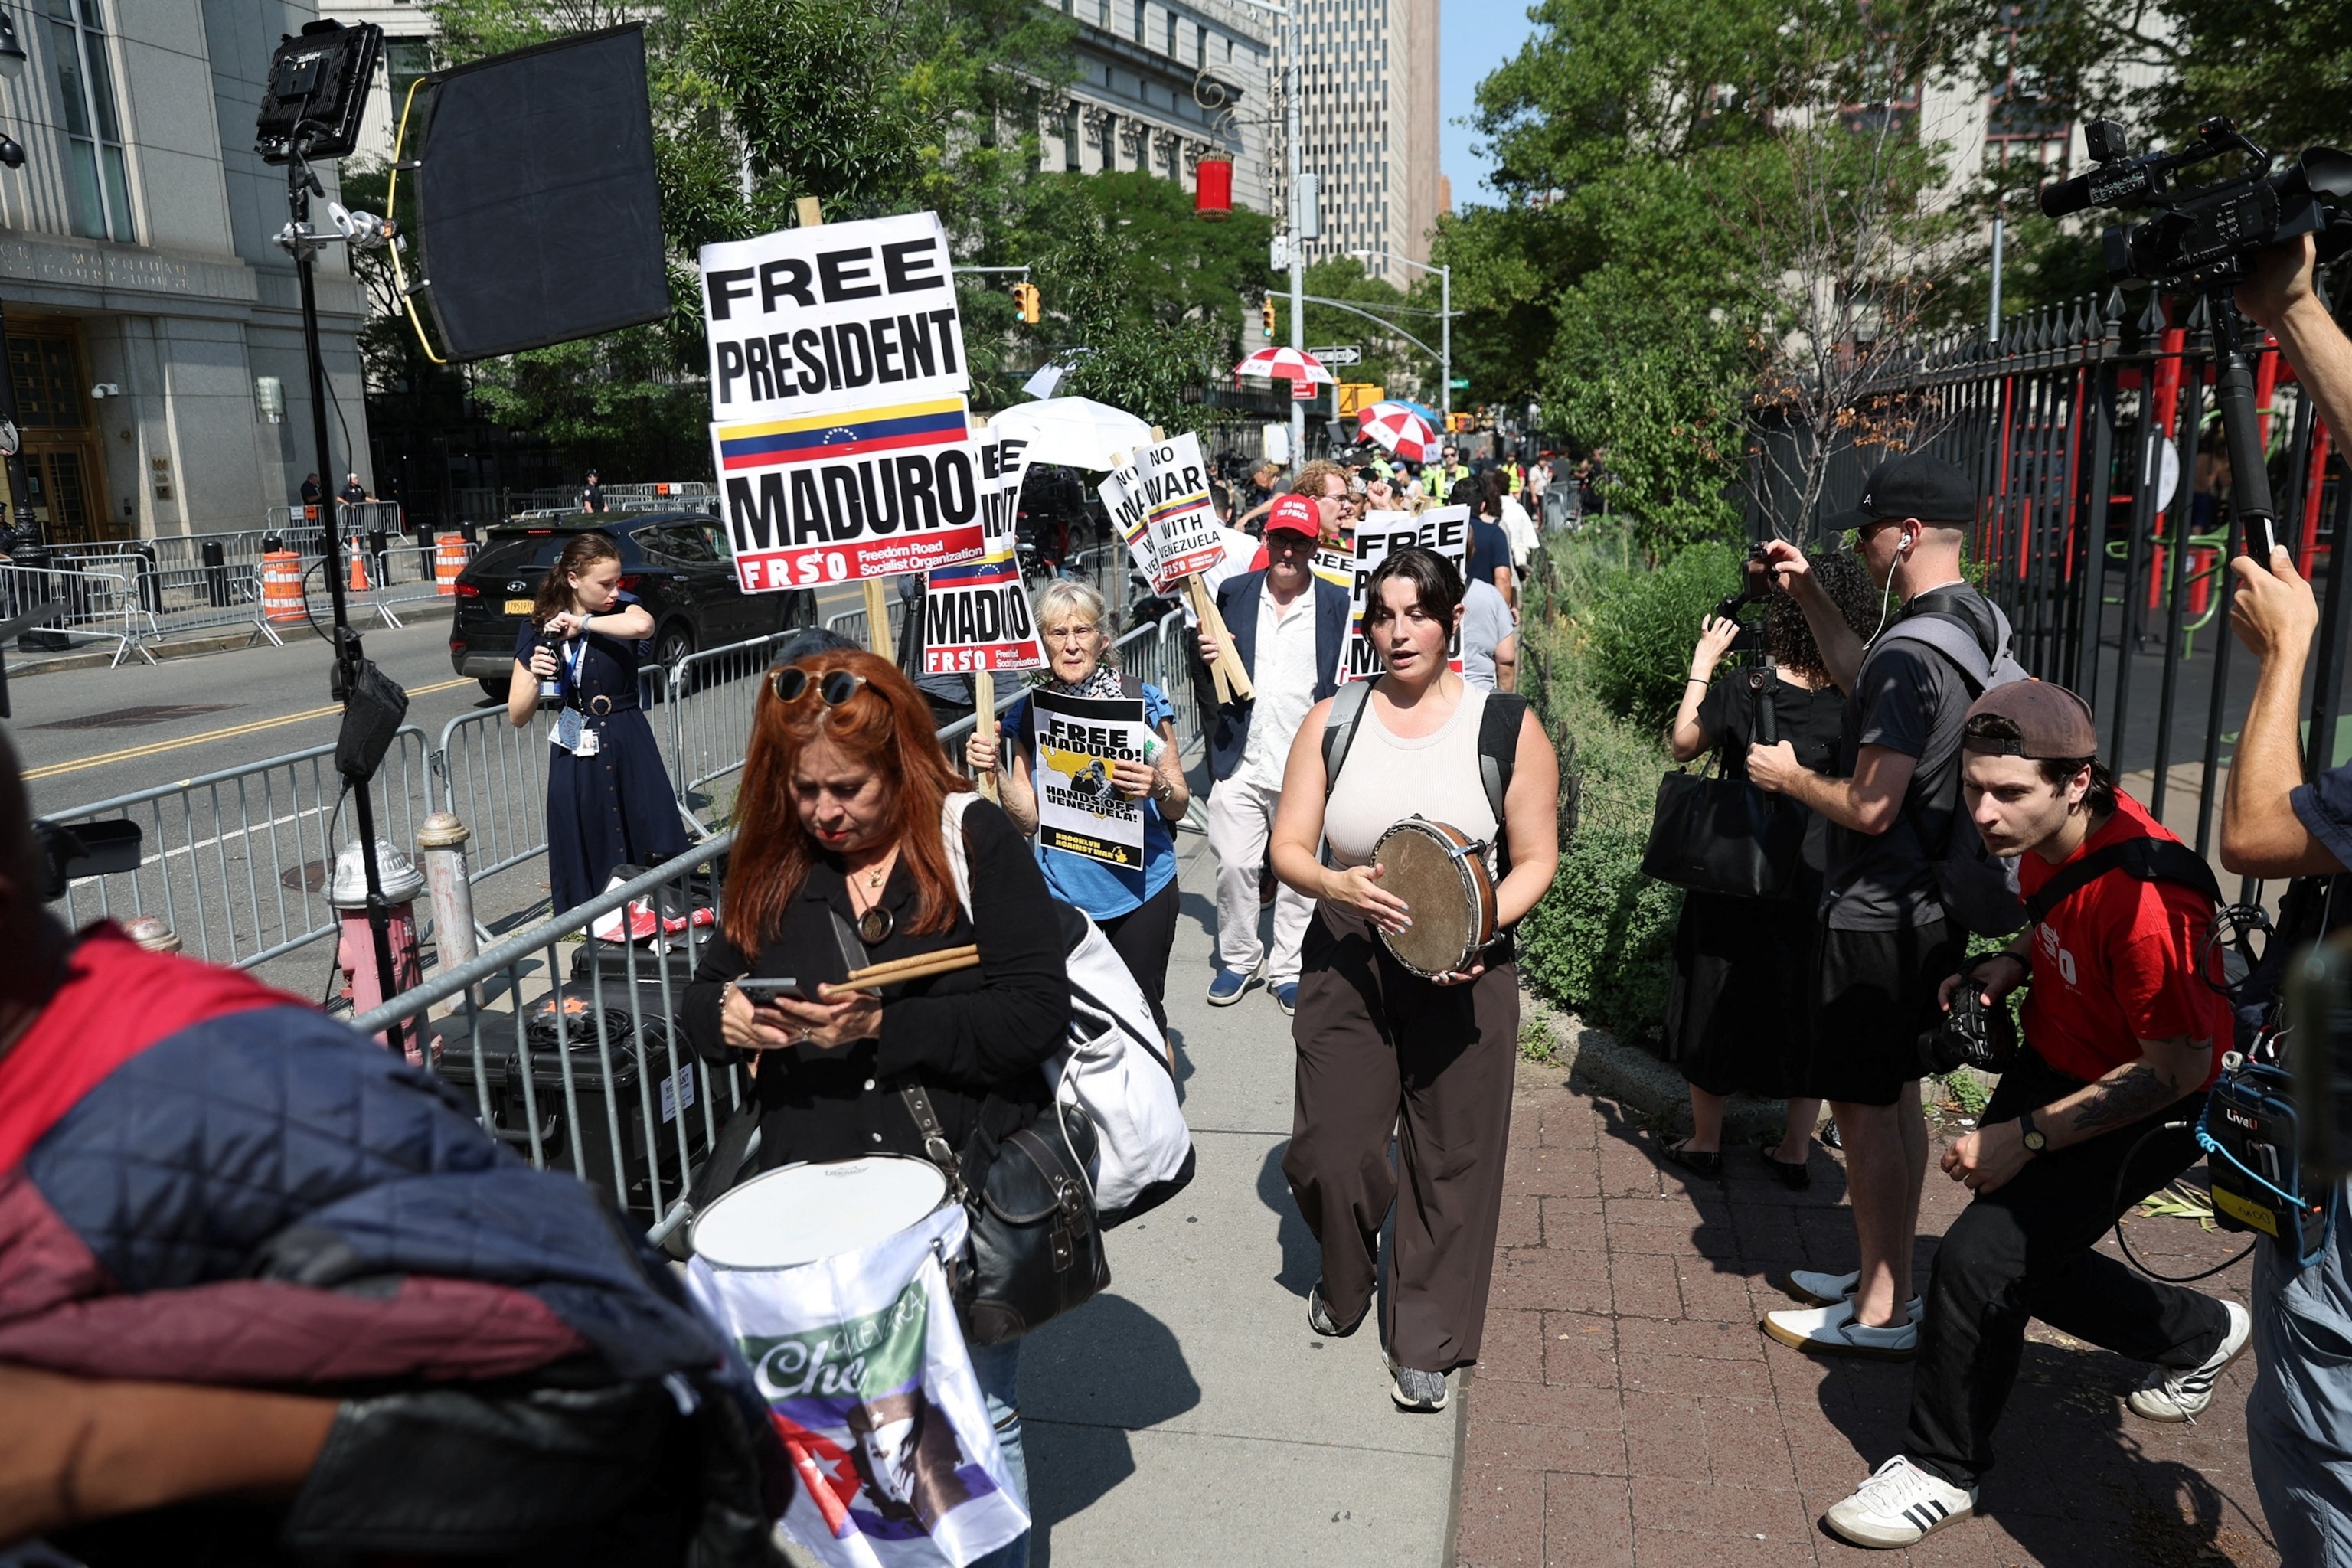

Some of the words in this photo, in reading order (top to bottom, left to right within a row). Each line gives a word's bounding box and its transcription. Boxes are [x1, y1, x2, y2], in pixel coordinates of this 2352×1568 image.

[707, 237, 946, 320] FREE
[716, 309, 958, 403] PRESIDENT
[1338, 351, 1354, 360] WAY
[975, 439, 1028, 479] EE
[1150, 446, 1174, 467] NO
[1116, 466, 1140, 488] NO
[1144, 466, 1204, 505] WAR
[726, 449, 978, 552] MADURO
[1161, 514, 1204, 540] WITH
[1287, 509, 1310, 521] PEACE
[858, 546, 909, 563] Freedom
[910, 539, 943, 557] Road
[1158, 530, 1221, 560] VENEZUELA
[743, 550, 848, 589] FRSO
[859, 557, 908, 576] Socialist
[909, 546, 984, 573] Organization
[1312, 553, 1353, 572] REE
[928, 648, 986, 671] FRSO
[1048, 718, 1129, 749] FREE
[1039, 733, 1142, 763] MADURO!
[1046, 785, 1100, 806] HANDS
[1102, 798, 1135, 813] OFF
[1047, 795, 1138, 824] VENEZUELA!
[1055, 832, 1101, 849] BROOKLYN
[1055, 839, 1093, 855] AGAINST
[1093, 848, 1114, 860] WAR
[2226, 1108, 2258, 1131] LiveU
[753, 1339, 869, 1399] Che
